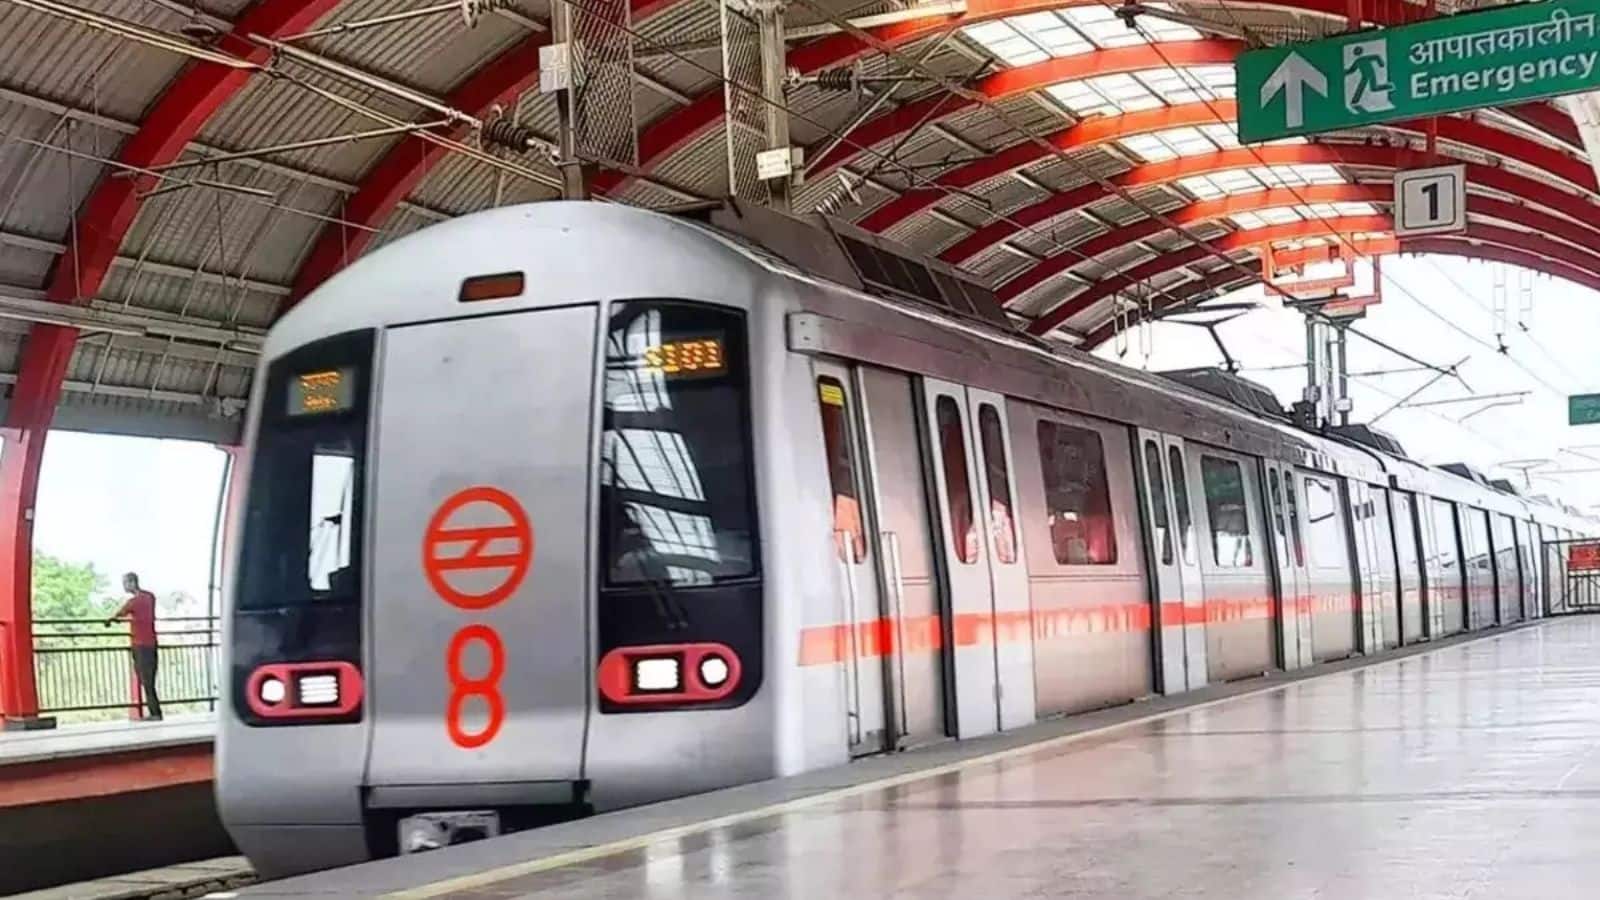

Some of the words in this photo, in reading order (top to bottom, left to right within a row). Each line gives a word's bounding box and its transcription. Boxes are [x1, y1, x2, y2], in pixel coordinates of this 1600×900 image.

[1409, 8, 1596, 65] आपातकालीन
[1410, 51, 1598, 99] Emergency
[1421, 182, 1440, 221] 1
[446, 623, 507, 750] 8
